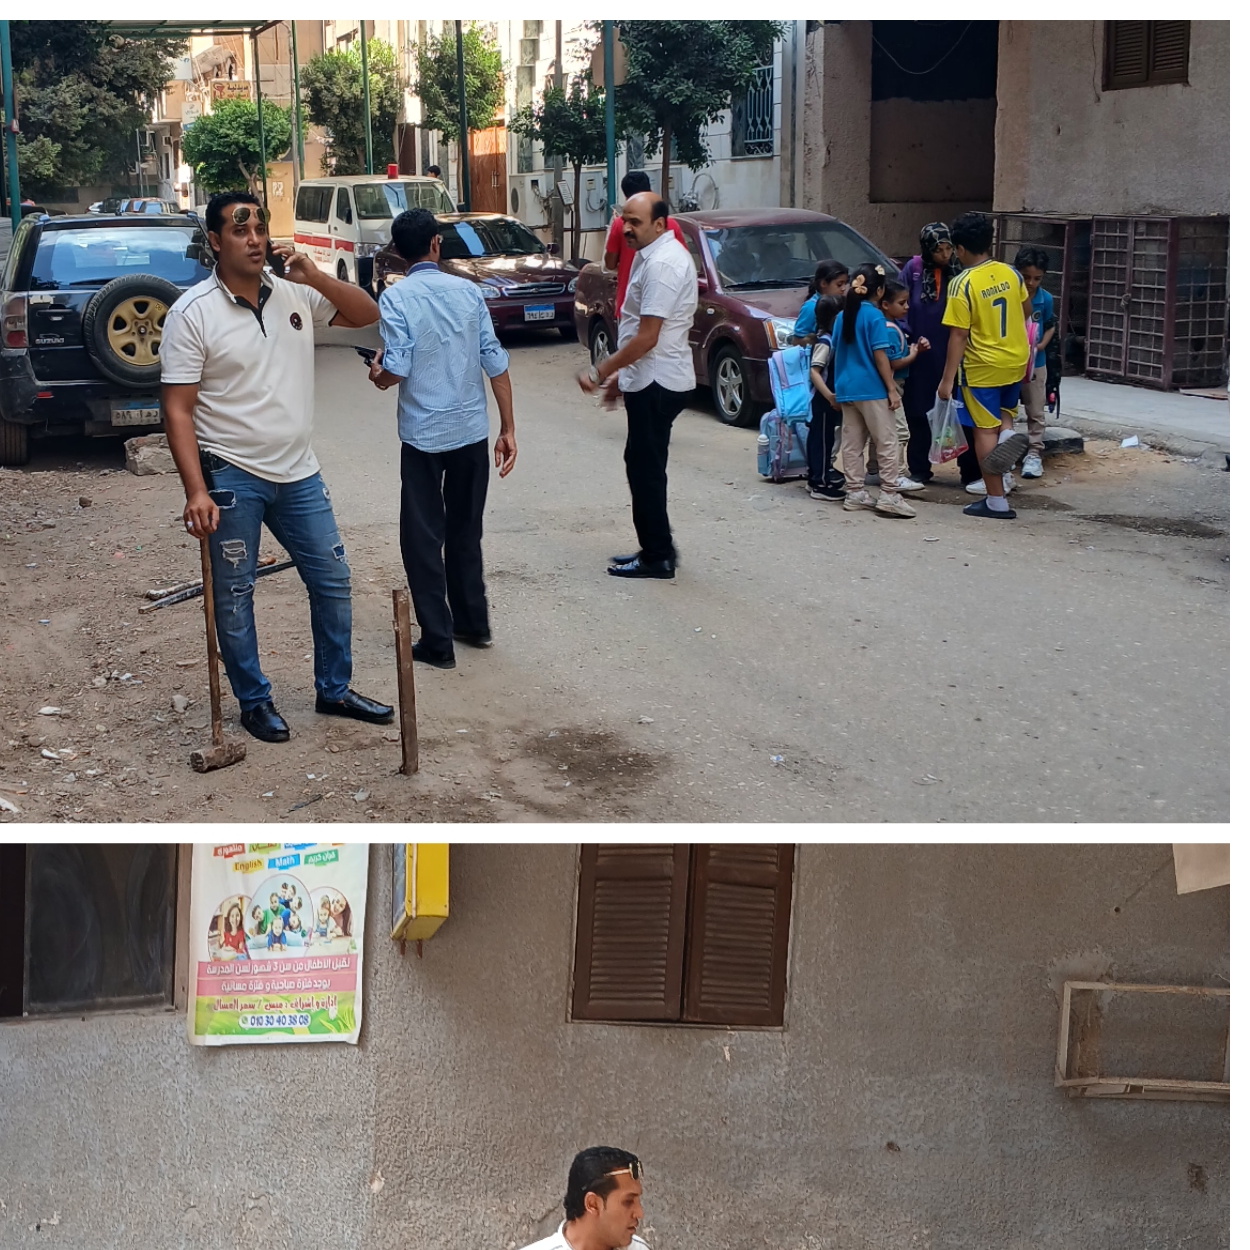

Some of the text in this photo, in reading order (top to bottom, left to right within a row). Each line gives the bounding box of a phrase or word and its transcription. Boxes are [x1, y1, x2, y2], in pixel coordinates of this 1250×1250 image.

[981, 281, 1011, 299] RONALDO
[992, 296, 1007, 338] 7
[234, 860, 263, 872] English
[275, 856, 296, 868] Math
[206, 963, 234, 976] المدرسة
[235, 964, 251, 975] لسن
[251, 962, 271, 975] شهور
[273, 961, 278, 971] 3
[279, 961, 292, 973] سن
[292, 960, 303, 972] من
[332, 959, 350, 971] نقبل
[249, 981, 264, 992] فترة
[271, 980, 296, 991] صباحية
[297, 979, 313, 990] فترة
[313, 978, 331, 990] يوجد
[250, 1014, 309, 1026] 010 30 40 38 08
